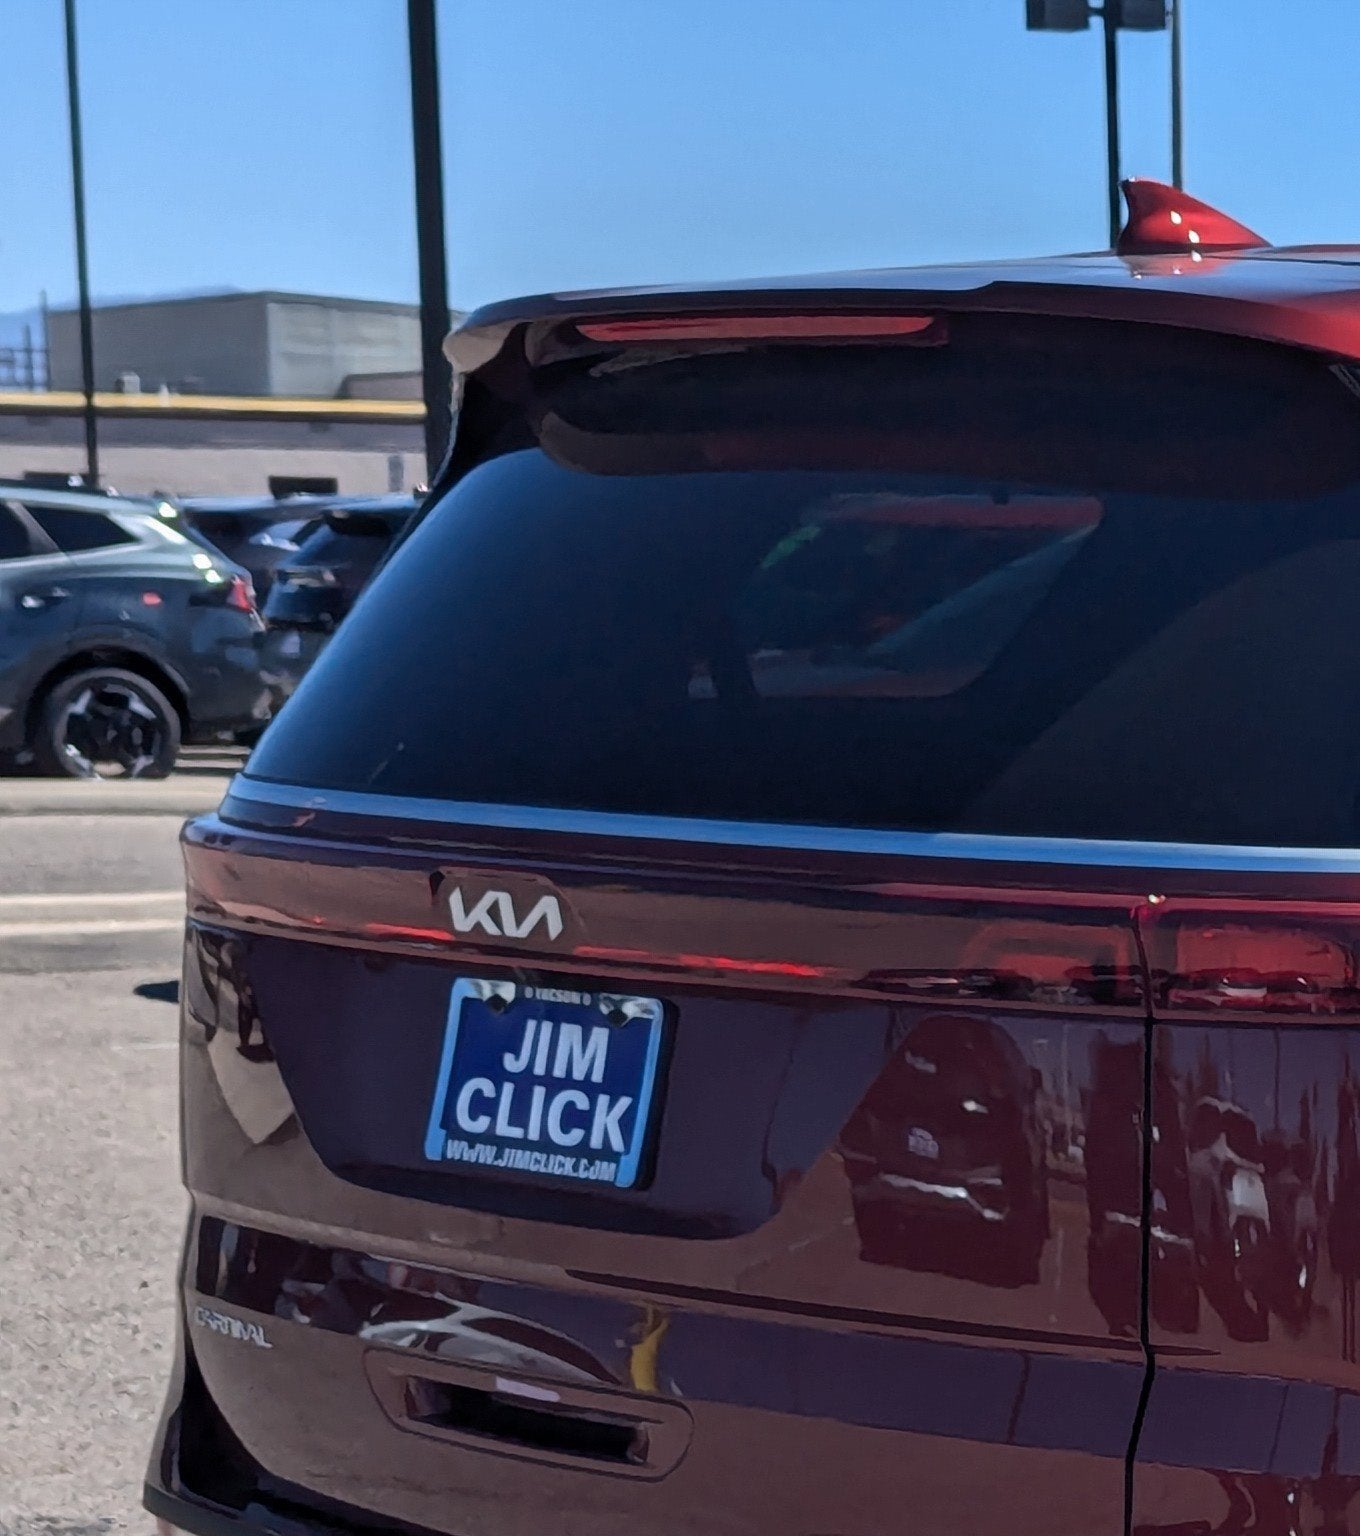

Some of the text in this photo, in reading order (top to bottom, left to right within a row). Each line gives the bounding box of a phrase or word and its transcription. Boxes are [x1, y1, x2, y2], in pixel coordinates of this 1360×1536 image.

[449, 886, 563, 941] KIA
[502, 1019, 610, 1084] JIM
[456, 1077, 633, 1153] CLICK
